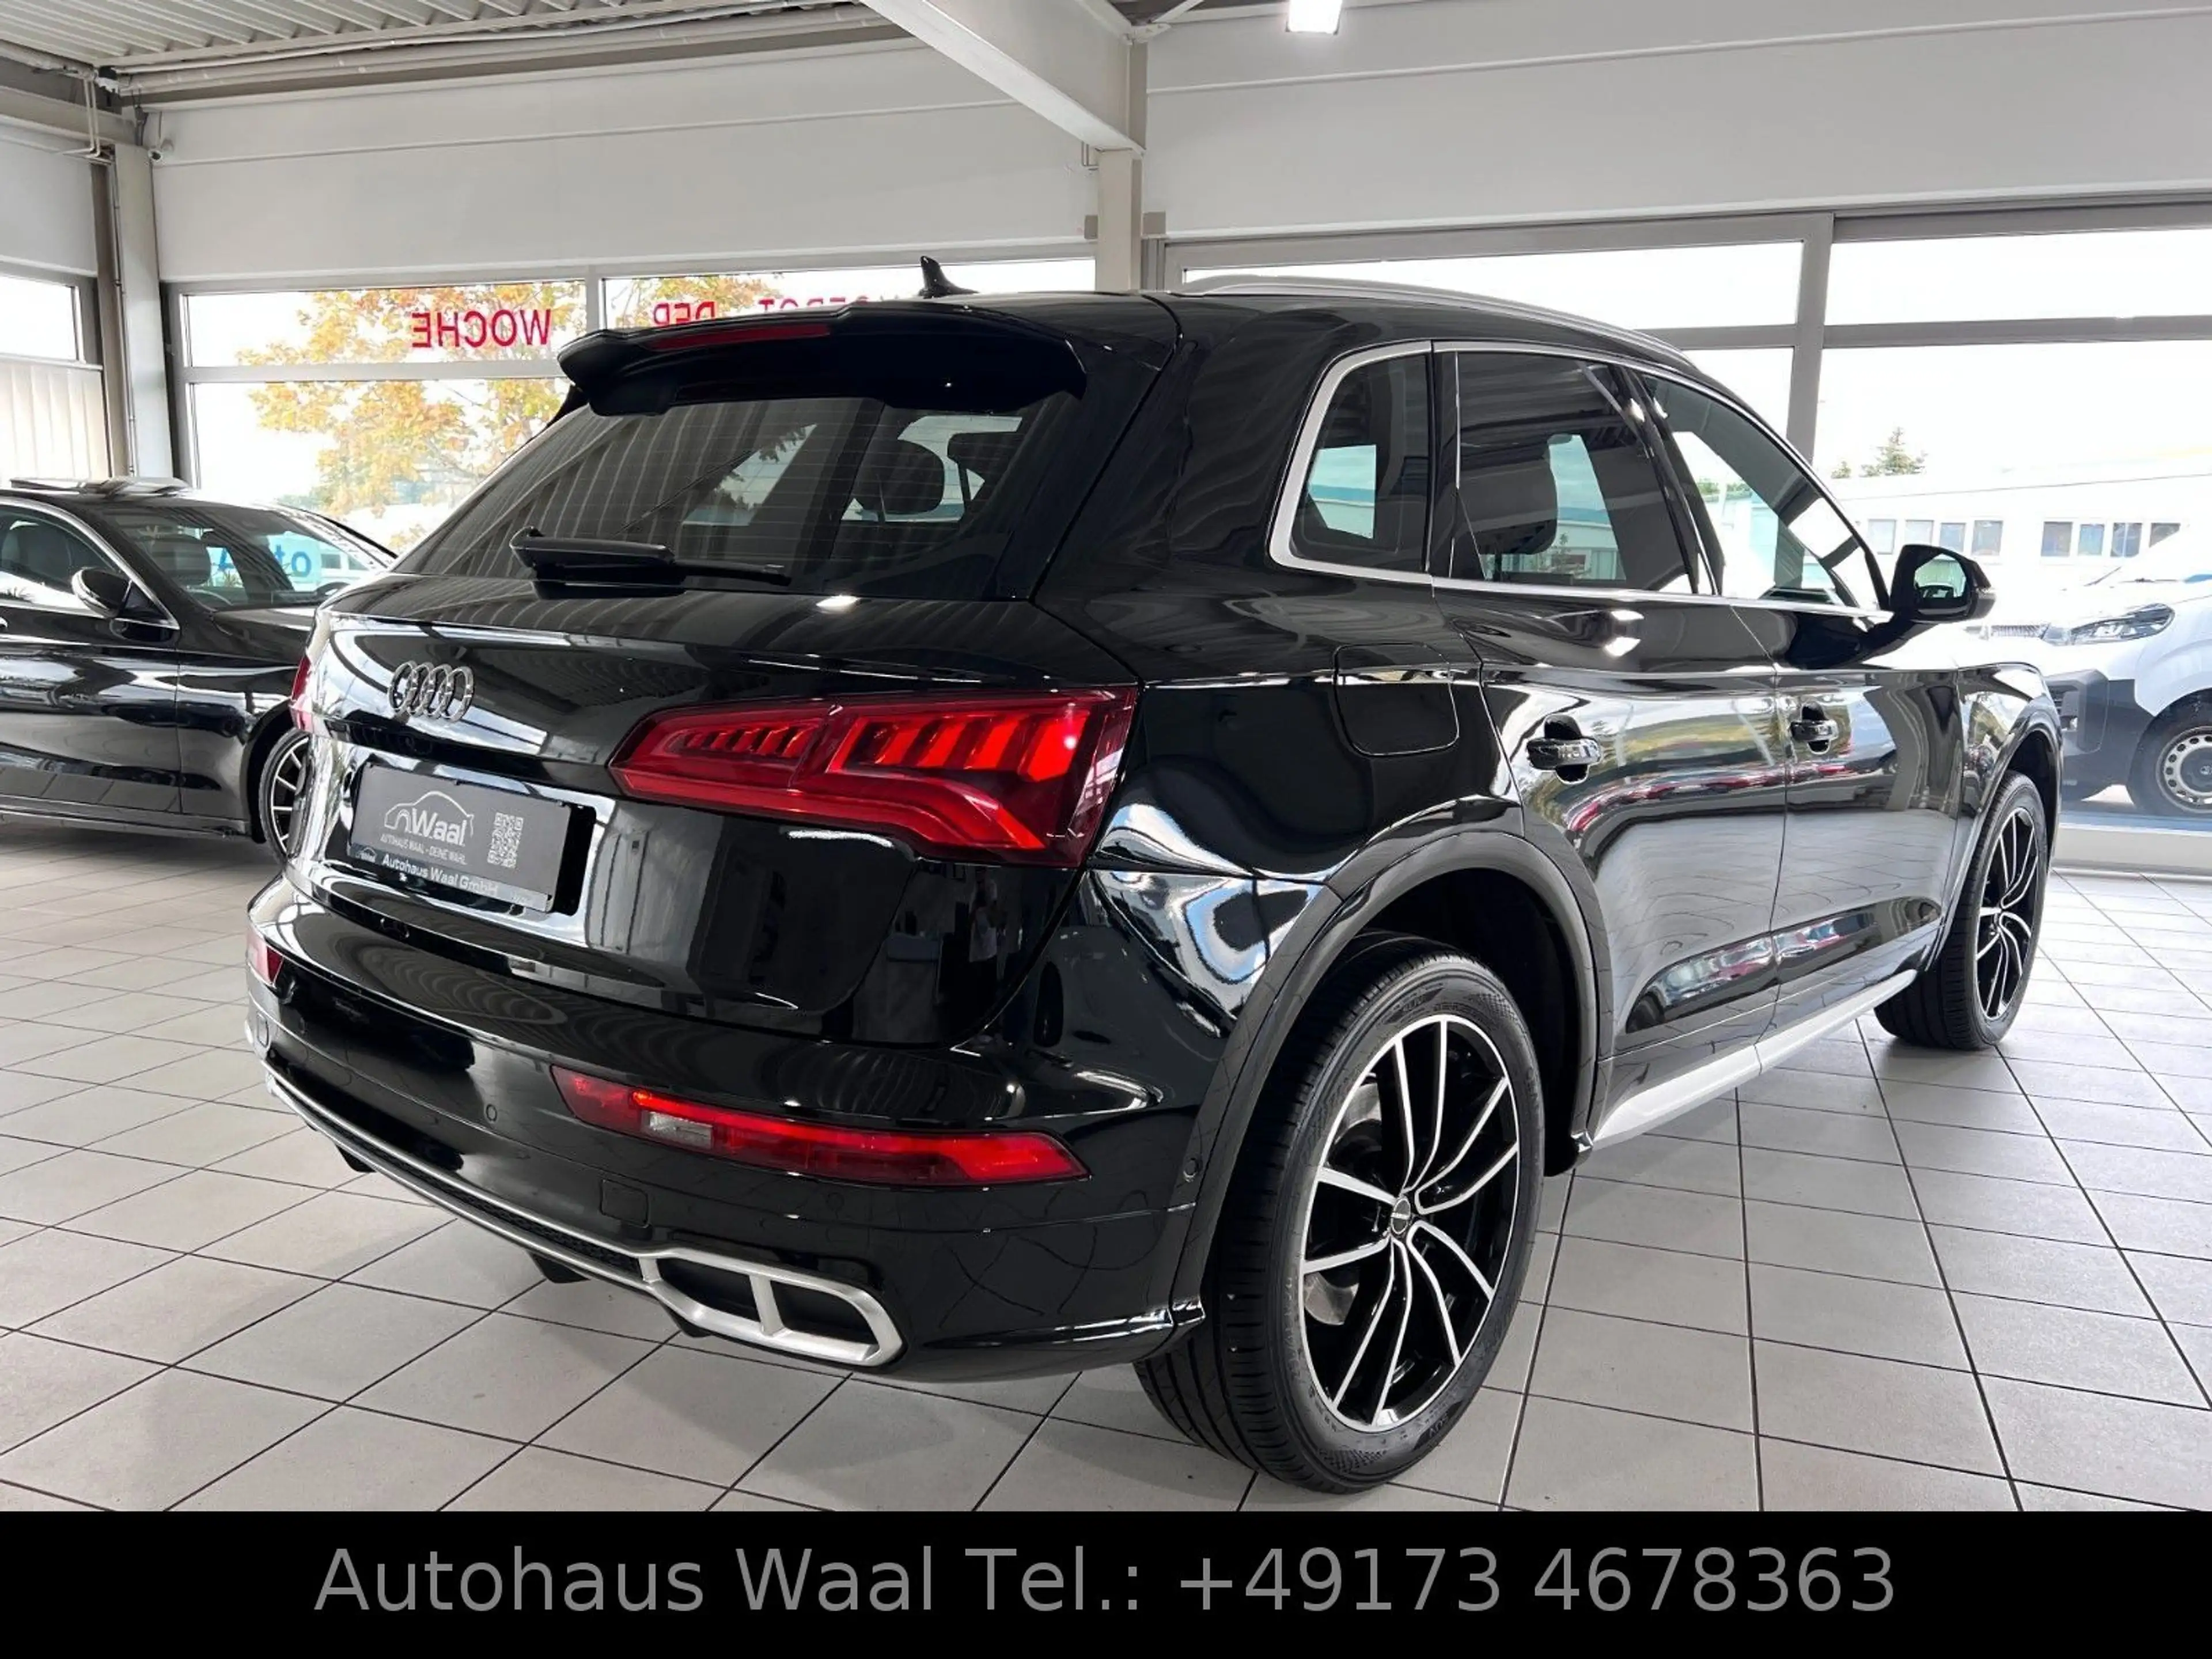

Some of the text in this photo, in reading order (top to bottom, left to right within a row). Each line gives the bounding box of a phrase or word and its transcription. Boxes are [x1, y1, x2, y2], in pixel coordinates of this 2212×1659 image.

[382, 853, 428, 879] Autohaus
[431, 866, 459, 887] Waal
[460, 875, 498, 897] GmbH
